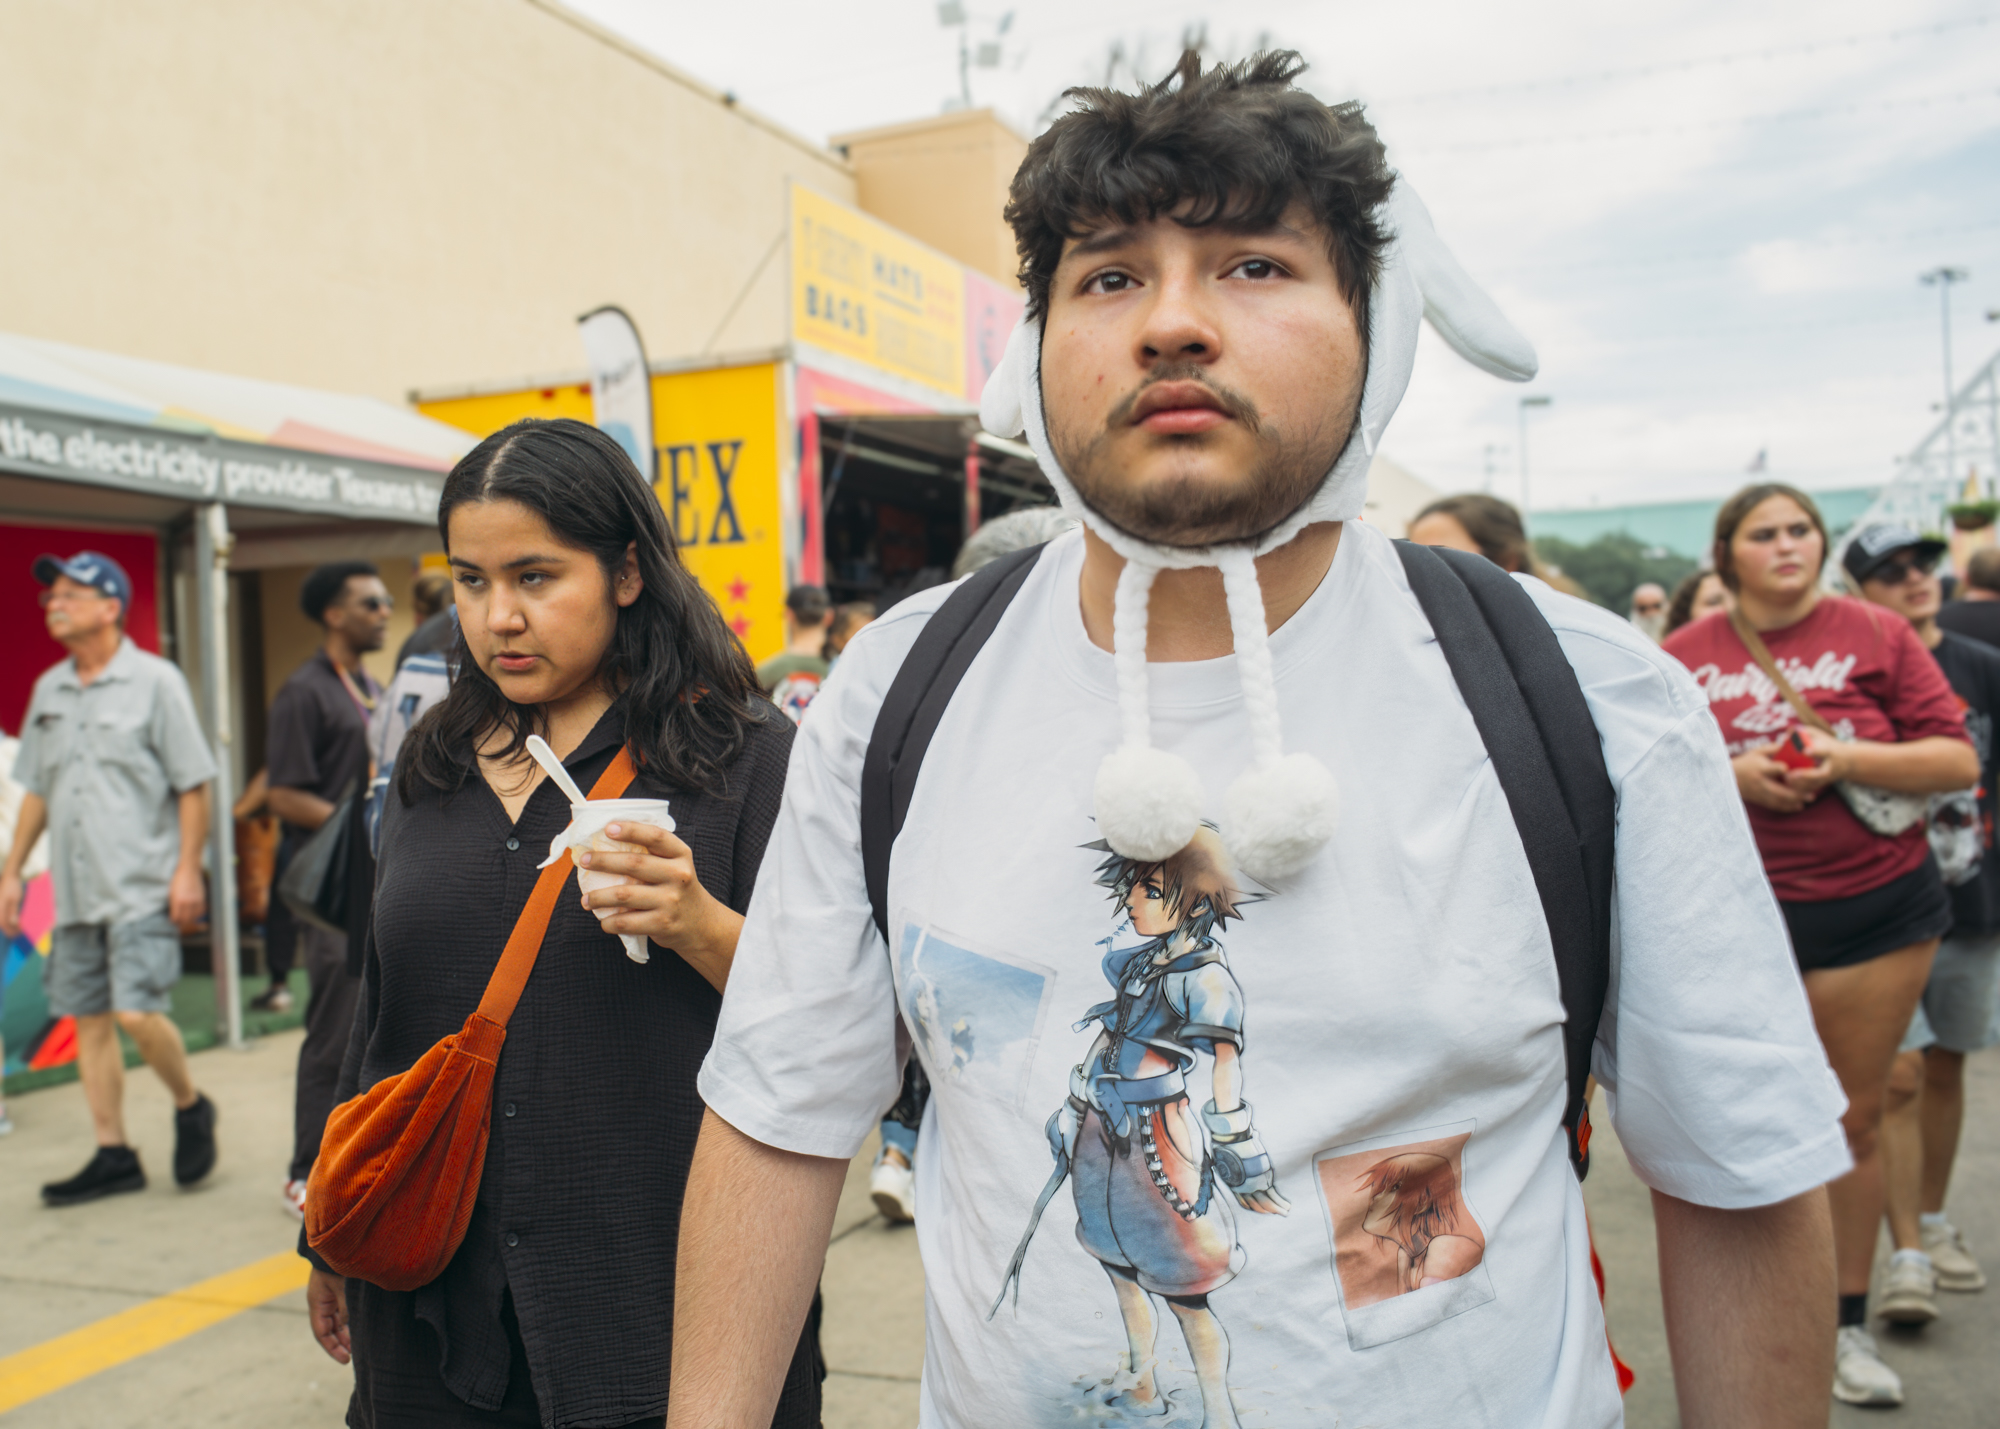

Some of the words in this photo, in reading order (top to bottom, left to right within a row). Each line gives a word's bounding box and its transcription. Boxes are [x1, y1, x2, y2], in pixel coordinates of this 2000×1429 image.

[805, 283, 868, 337] BAGS
[0, 417, 62, 464] the
[64, 429, 219, 497] electricity
[222, 459, 333, 499] provider
[332, 465, 417, 512] Texans
[652, 439, 746, 547] EX
